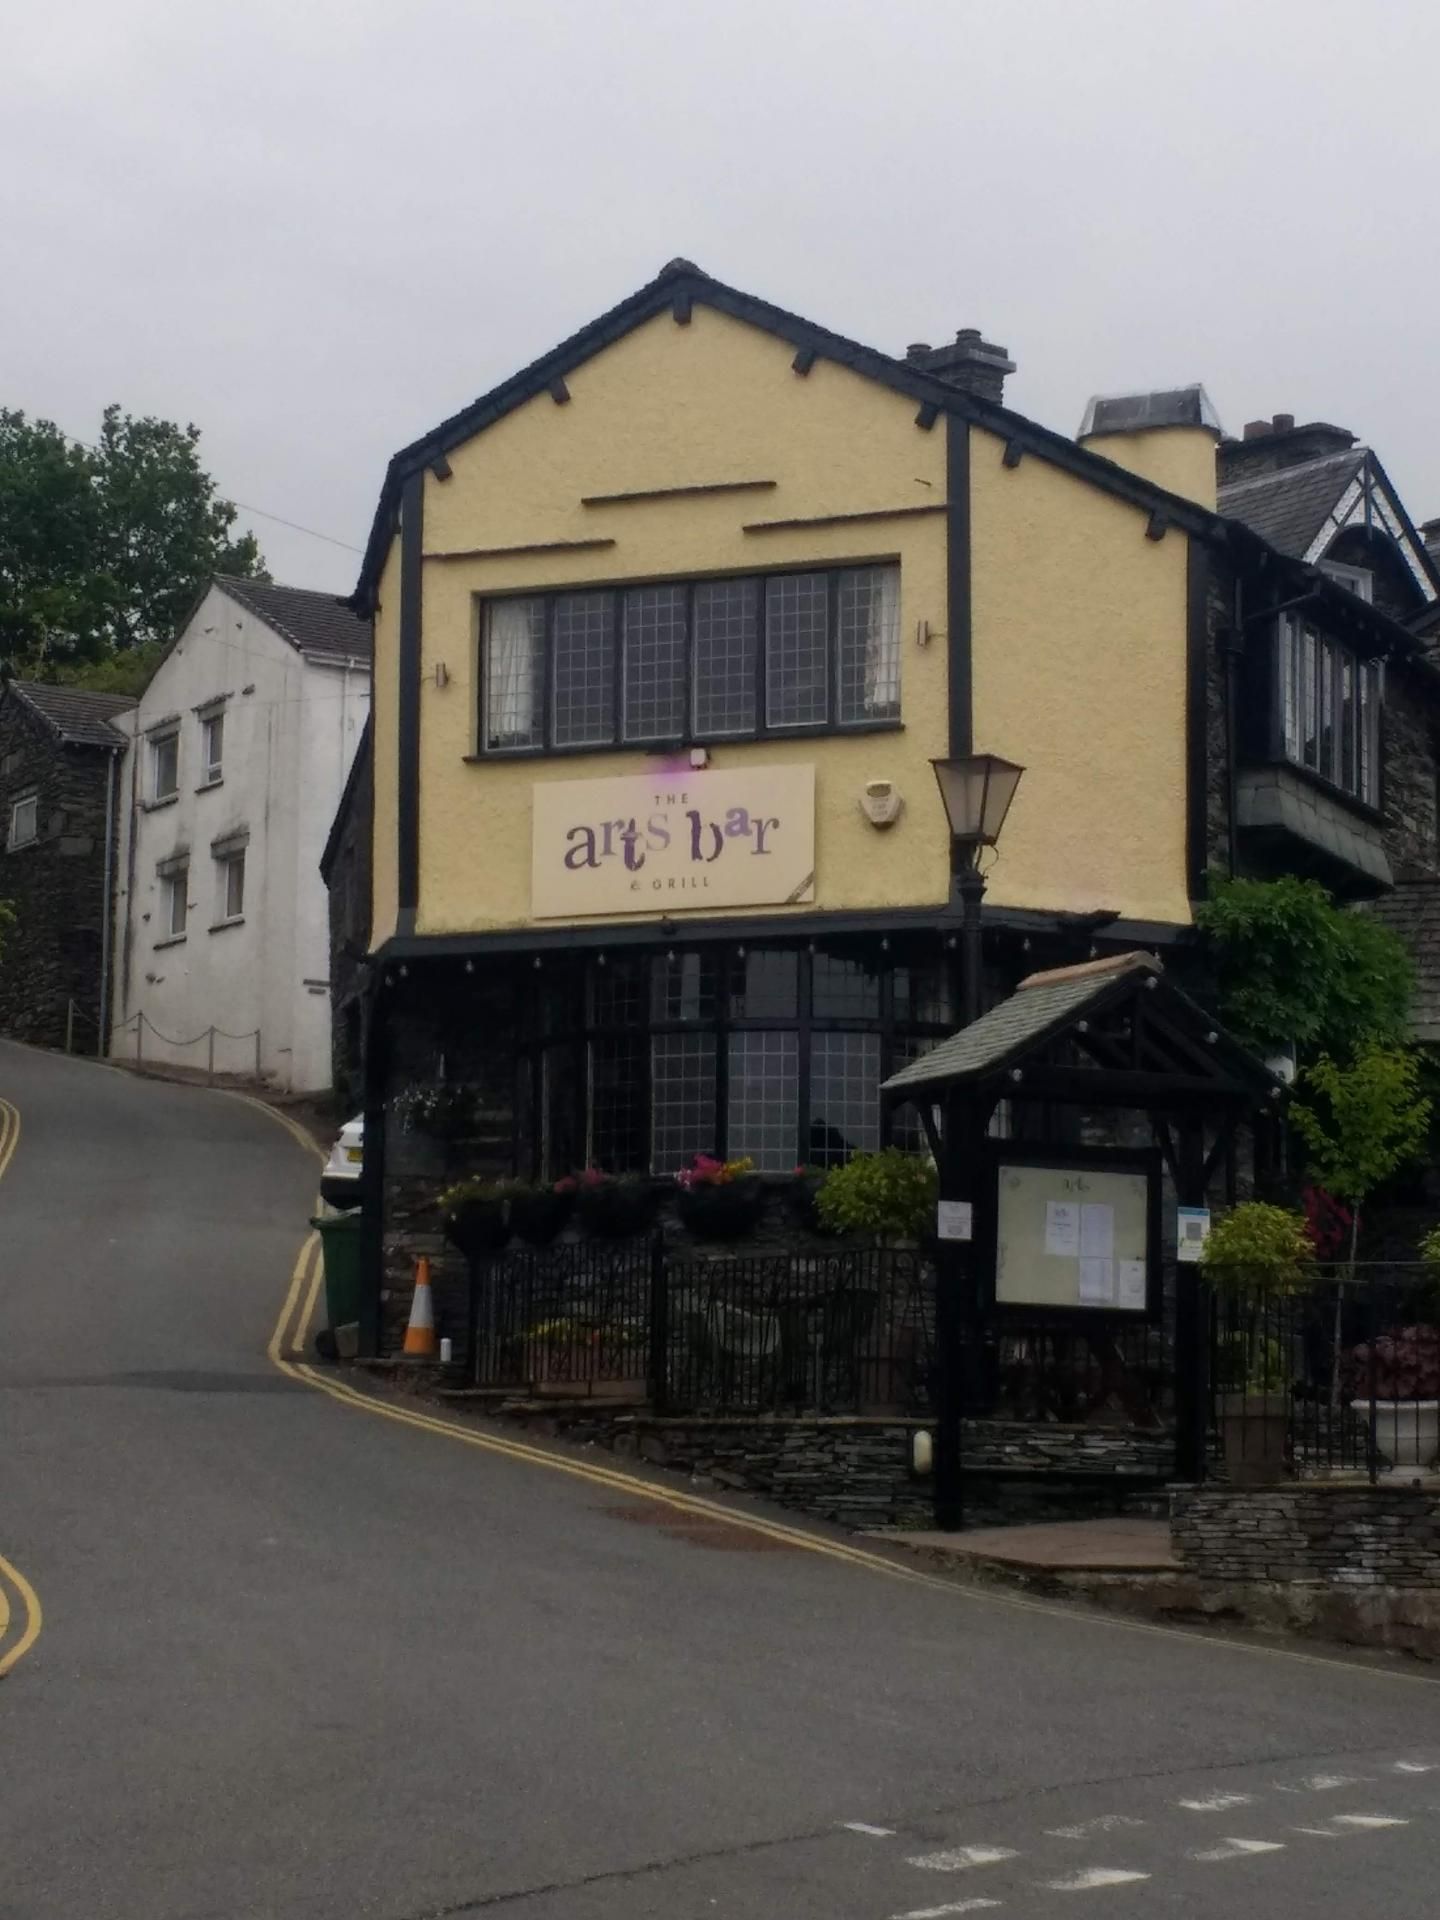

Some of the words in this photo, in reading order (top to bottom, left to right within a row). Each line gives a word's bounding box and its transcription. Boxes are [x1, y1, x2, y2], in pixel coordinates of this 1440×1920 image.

[655, 793, 689, 806] THE
[564, 813, 671, 872] arts
[686, 807, 780, 862] bar
[652, 876, 710, 890] GRILL
